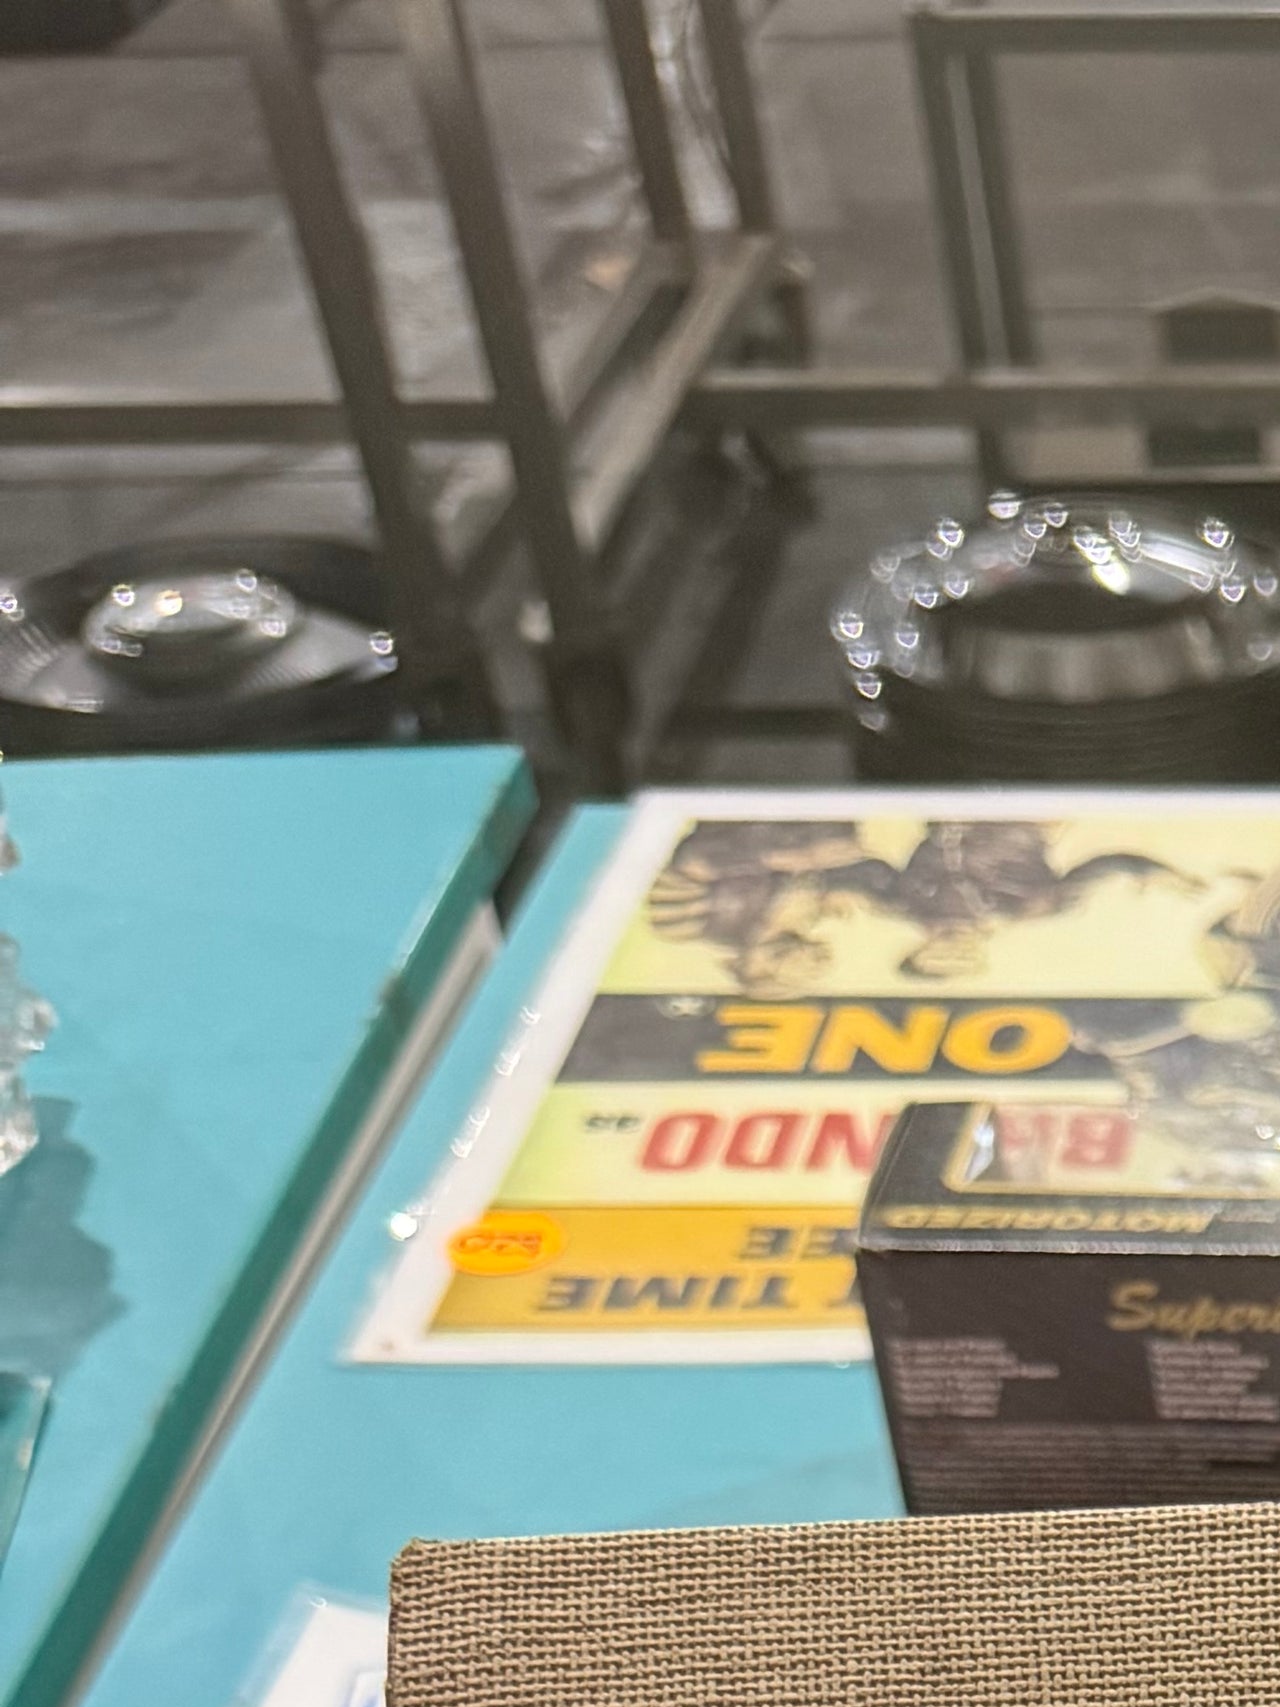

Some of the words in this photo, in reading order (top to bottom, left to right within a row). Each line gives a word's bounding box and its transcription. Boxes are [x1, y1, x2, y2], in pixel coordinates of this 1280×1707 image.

[696, 1003, 1073, 1075] ONE
[883, 1205, 1217, 1233] MOTORIZED
[537, 1276, 797, 1311] TIME
